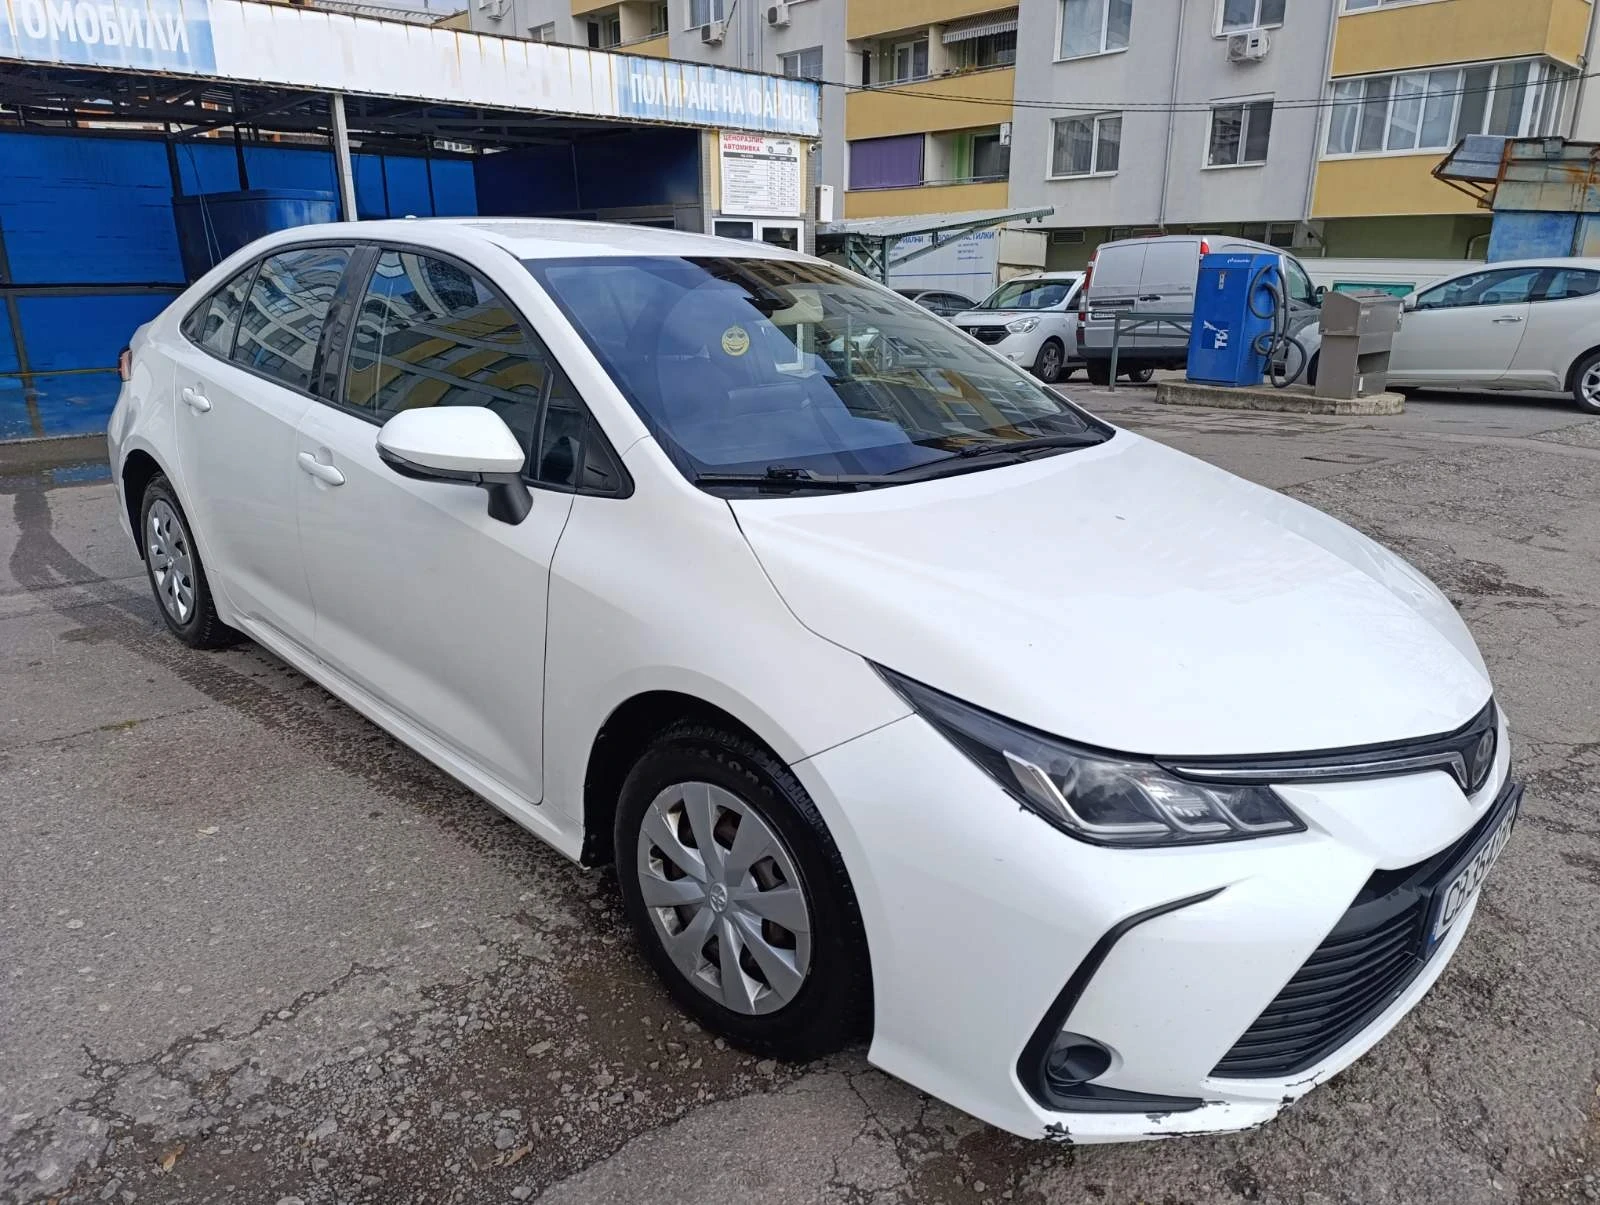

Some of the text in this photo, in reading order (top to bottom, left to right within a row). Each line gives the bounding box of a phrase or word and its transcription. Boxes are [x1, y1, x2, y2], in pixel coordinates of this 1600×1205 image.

[630, 72, 719, 112] ПОЛИРАНЕ
[722, 85, 745, 115] НА
[723, 133, 764, 144] ЦЕНОРАЗПИС
[723, 143, 760, 152] АВТОМИВКА
